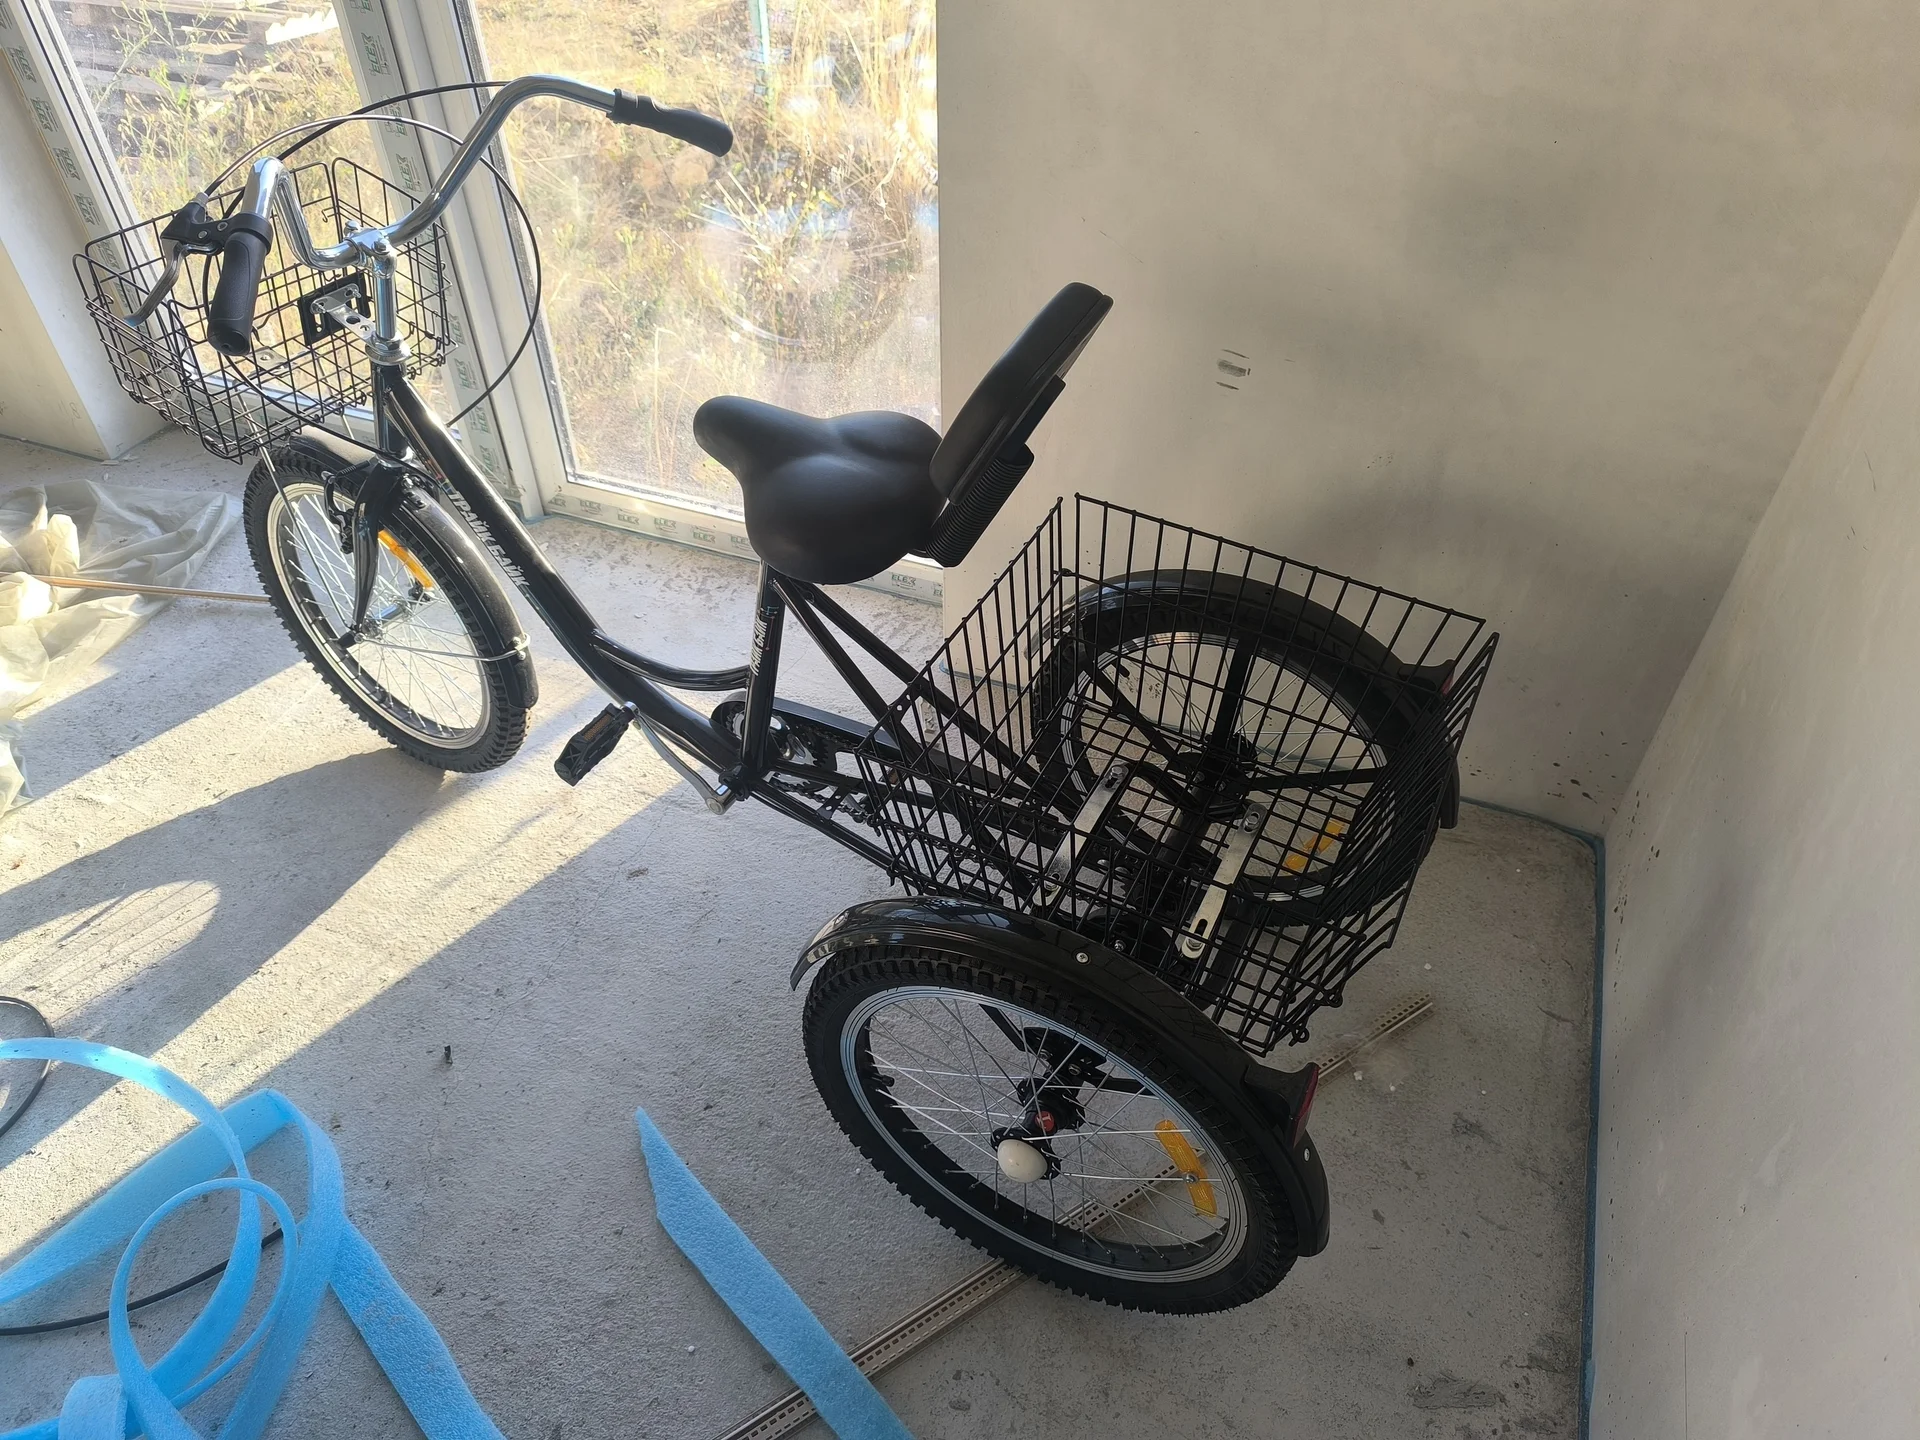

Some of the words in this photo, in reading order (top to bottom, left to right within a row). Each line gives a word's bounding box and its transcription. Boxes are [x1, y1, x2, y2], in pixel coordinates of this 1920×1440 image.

[361, 33, 381, 74] ELEX
[449, 491, 496, 543] ТРАЙК
[488, 544, 530, 587] БАЙК
[891, 574, 916, 586] ELEX
